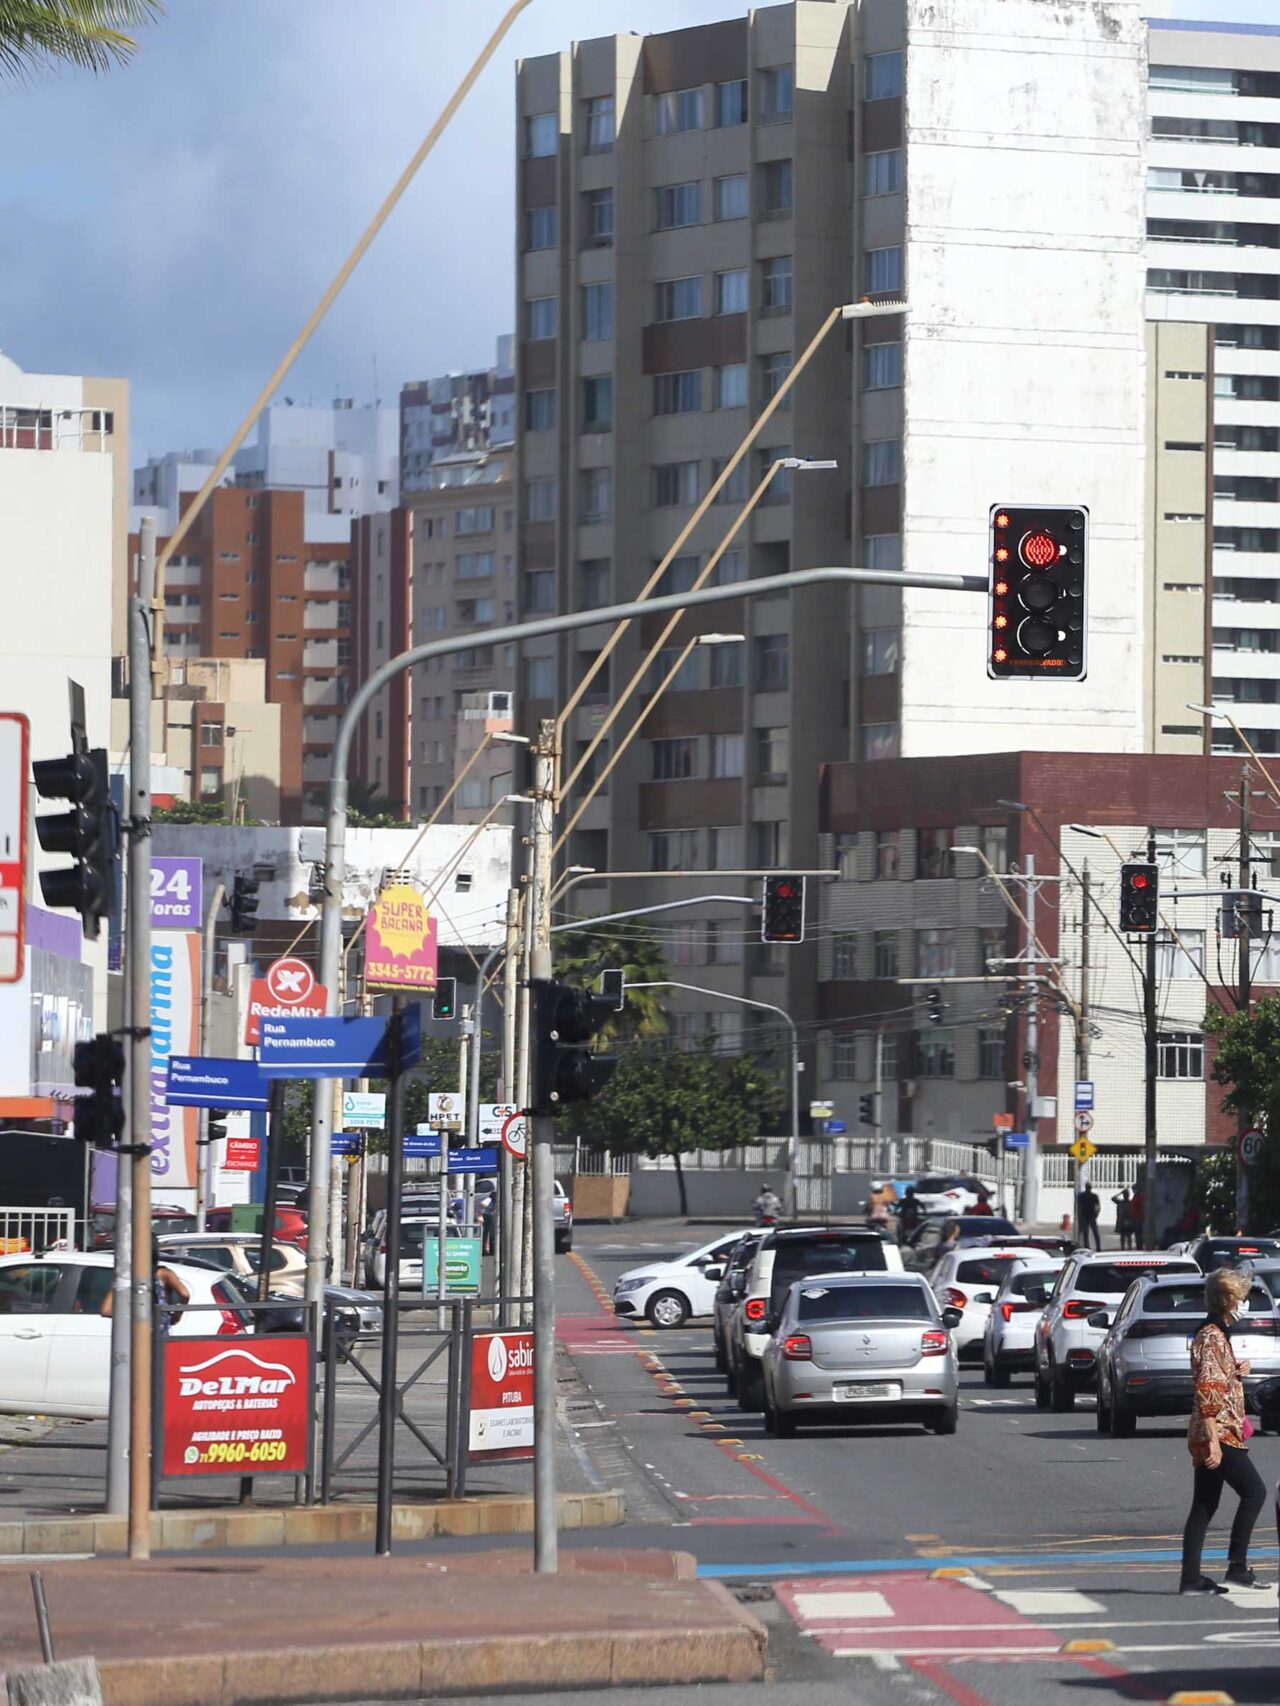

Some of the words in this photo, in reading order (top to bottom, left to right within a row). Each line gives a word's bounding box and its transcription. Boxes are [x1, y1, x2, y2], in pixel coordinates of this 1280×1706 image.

[149, 868, 192, 901] 24
[381, 901, 423, 919] SUPER
[381, 916, 423, 932] BACANA
[368, 961, 434, 981] 3345-5772
[263, 1023, 287, 1034] Rua
[263, 1036, 336, 1048] Pernambuco
[171, 1060, 192, 1071] Rua
[170, 1072, 229, 1085] Pernambuco
[1243, 1136, 1263, 1154] 60
[502, 1391, 522, 1404] PITUBA
[192, 1399, 235, 1412] AUTOPEÇAS
[243, 1398, 279, 1409] BATERIAS
[191, 1430, 230, 1441] AGILIDADE
[237, 1429, 259, 1442] PREÇO
[260, 1429, 282, 1440] BAIXO
[208, 1441, 287, 1463] 9960-6050
